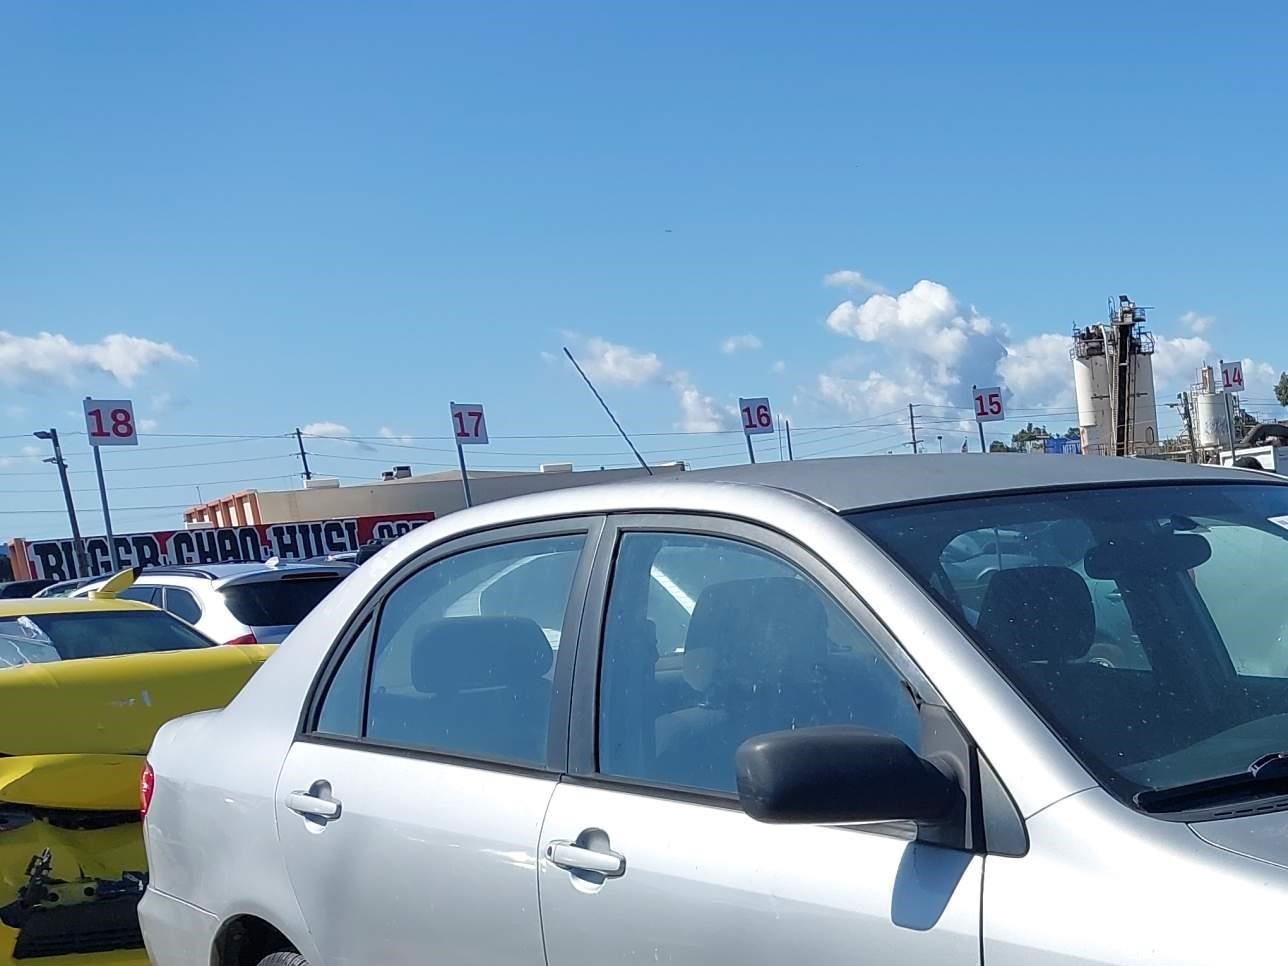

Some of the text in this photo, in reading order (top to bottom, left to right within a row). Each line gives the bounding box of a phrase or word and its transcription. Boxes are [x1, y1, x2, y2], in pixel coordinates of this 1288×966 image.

[1222, 367, 1242, 387] 14
[975, 393, 1001, 416] 15
[88, 408, 134, 437] 18
[454, 411, 482, 437] 17
[742, 405, 770, 428] 16
